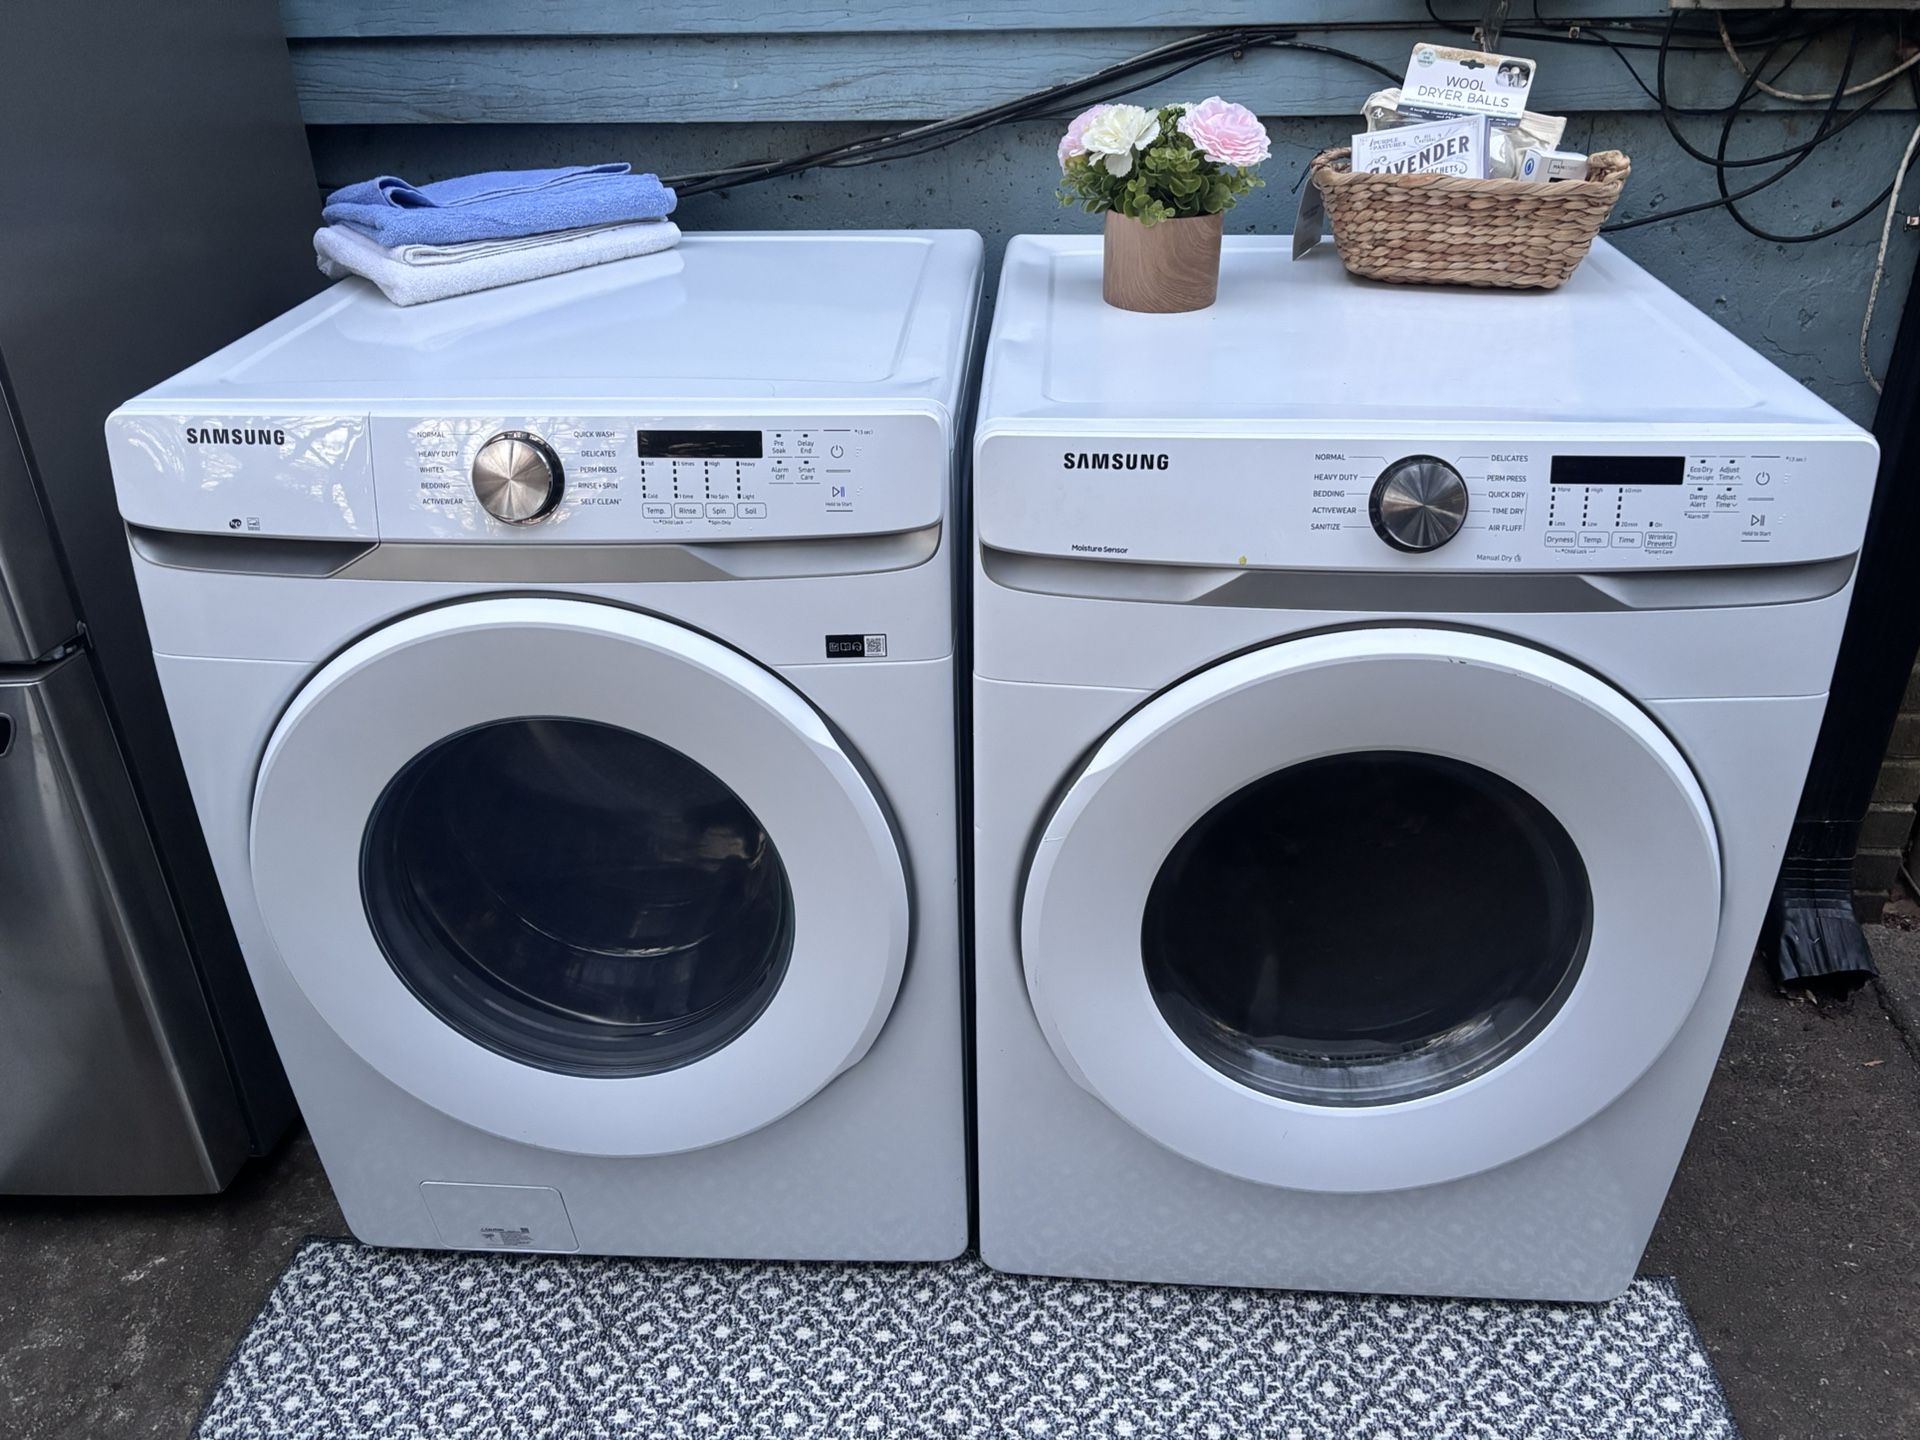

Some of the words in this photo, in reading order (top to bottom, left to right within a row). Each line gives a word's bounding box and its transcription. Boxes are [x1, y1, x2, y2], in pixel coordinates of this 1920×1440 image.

[1446, 75, 1487, 92] WOOL
[1418, 85, 1463, 101] DRYER
[1467, 93, 1509, 108] BALLS
[186, 428, 285, 445] SAMSUNG
[573, 431, 593, 439] QUICK
[797, 440, 814, 448] Delay
[581, 450, 616, 458] DELICATES
[1063, 453, 1169, 470] SAMSUNG
[580, 466, 598, 474] PERM
[599, 466, 617, 474] PRESS
[1720, 466, 1740, 474] Adjust
[421, 482, 450, 490] BEDDING
[1313, 490, 1345, 498] BEDDING
[1488, 491, 1510, 499] QUICK
[1511, 491, 1526, 499] DRY
[422, 498, 463, 506] ACTIVEWEAR
[647, 507, 665, 515] Temp.
[678, 507, 697, 515] Rinse
[712, 507, 727, 515] Spin
[744, 507, 757, 515] Soil
[1492, 507, 1508, 515] TIME
[1509, 507, 1524, 515] DRY
[1310, 523, 1341, 531] SANITIZE
[1488, 524, 1501, 532] AIR
[1501, 524, 1523, 532] FLUFF
[1546, 536, 1574, 544] Dryness
[1071, 544, 1103, 553] Moisture
[1103, 546, 1129, 554] Sensor
[1500, 554, 1512, 563] Dry
